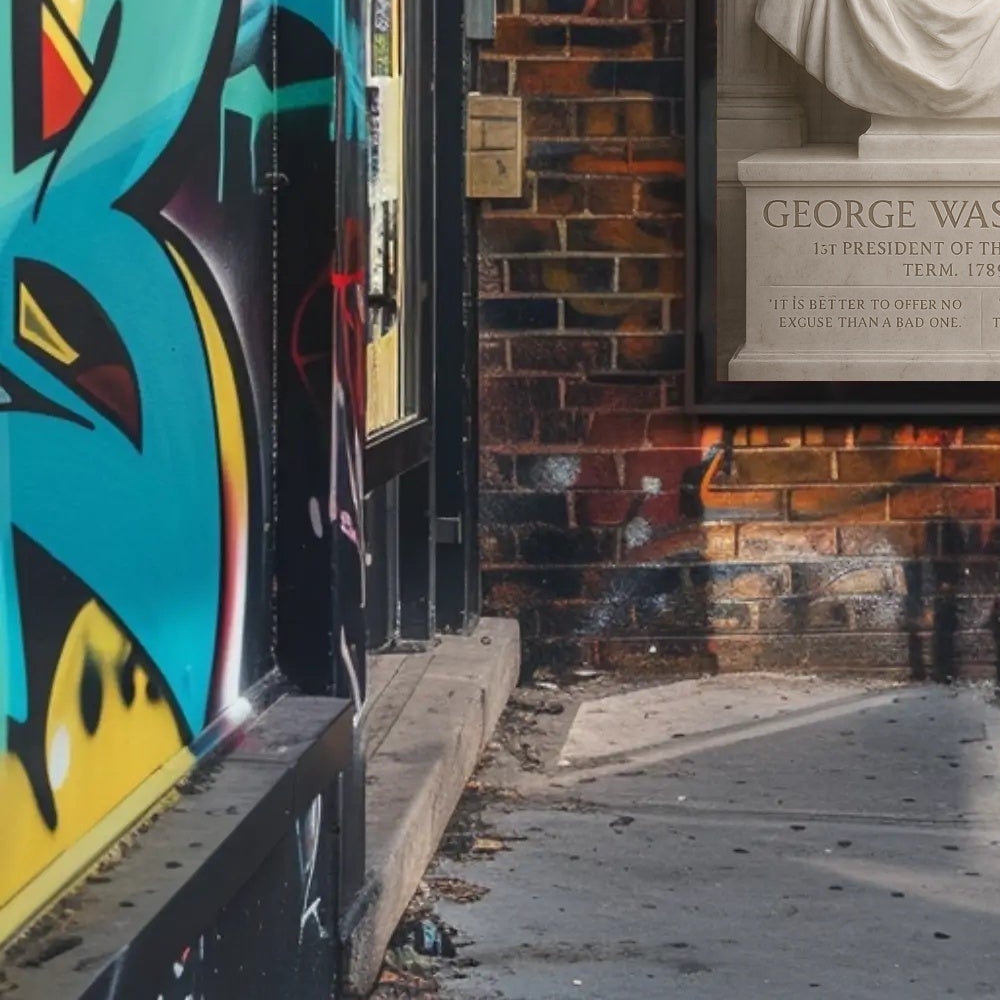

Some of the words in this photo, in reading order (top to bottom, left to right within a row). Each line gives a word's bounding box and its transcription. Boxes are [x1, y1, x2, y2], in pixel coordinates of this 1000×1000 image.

[763, 199, 917, 229] GEORGE
[842, 241, 945, 256] PRESIDENT
[950, 241, 974, 256] OF
[902, 263, 958, 277] TERM.
[809, 298, 865, 310] BETTER
[870, 298, 891, 310] TO
[894, 298, 937, 310] OFFER
[941, 298, 963, 310] NO
[838, 316, 879, 328] THAN
[882, 316, 892, 328] A
[896, 316, 925, 328] BAD
[929, 316, 962, 328] ONE.
